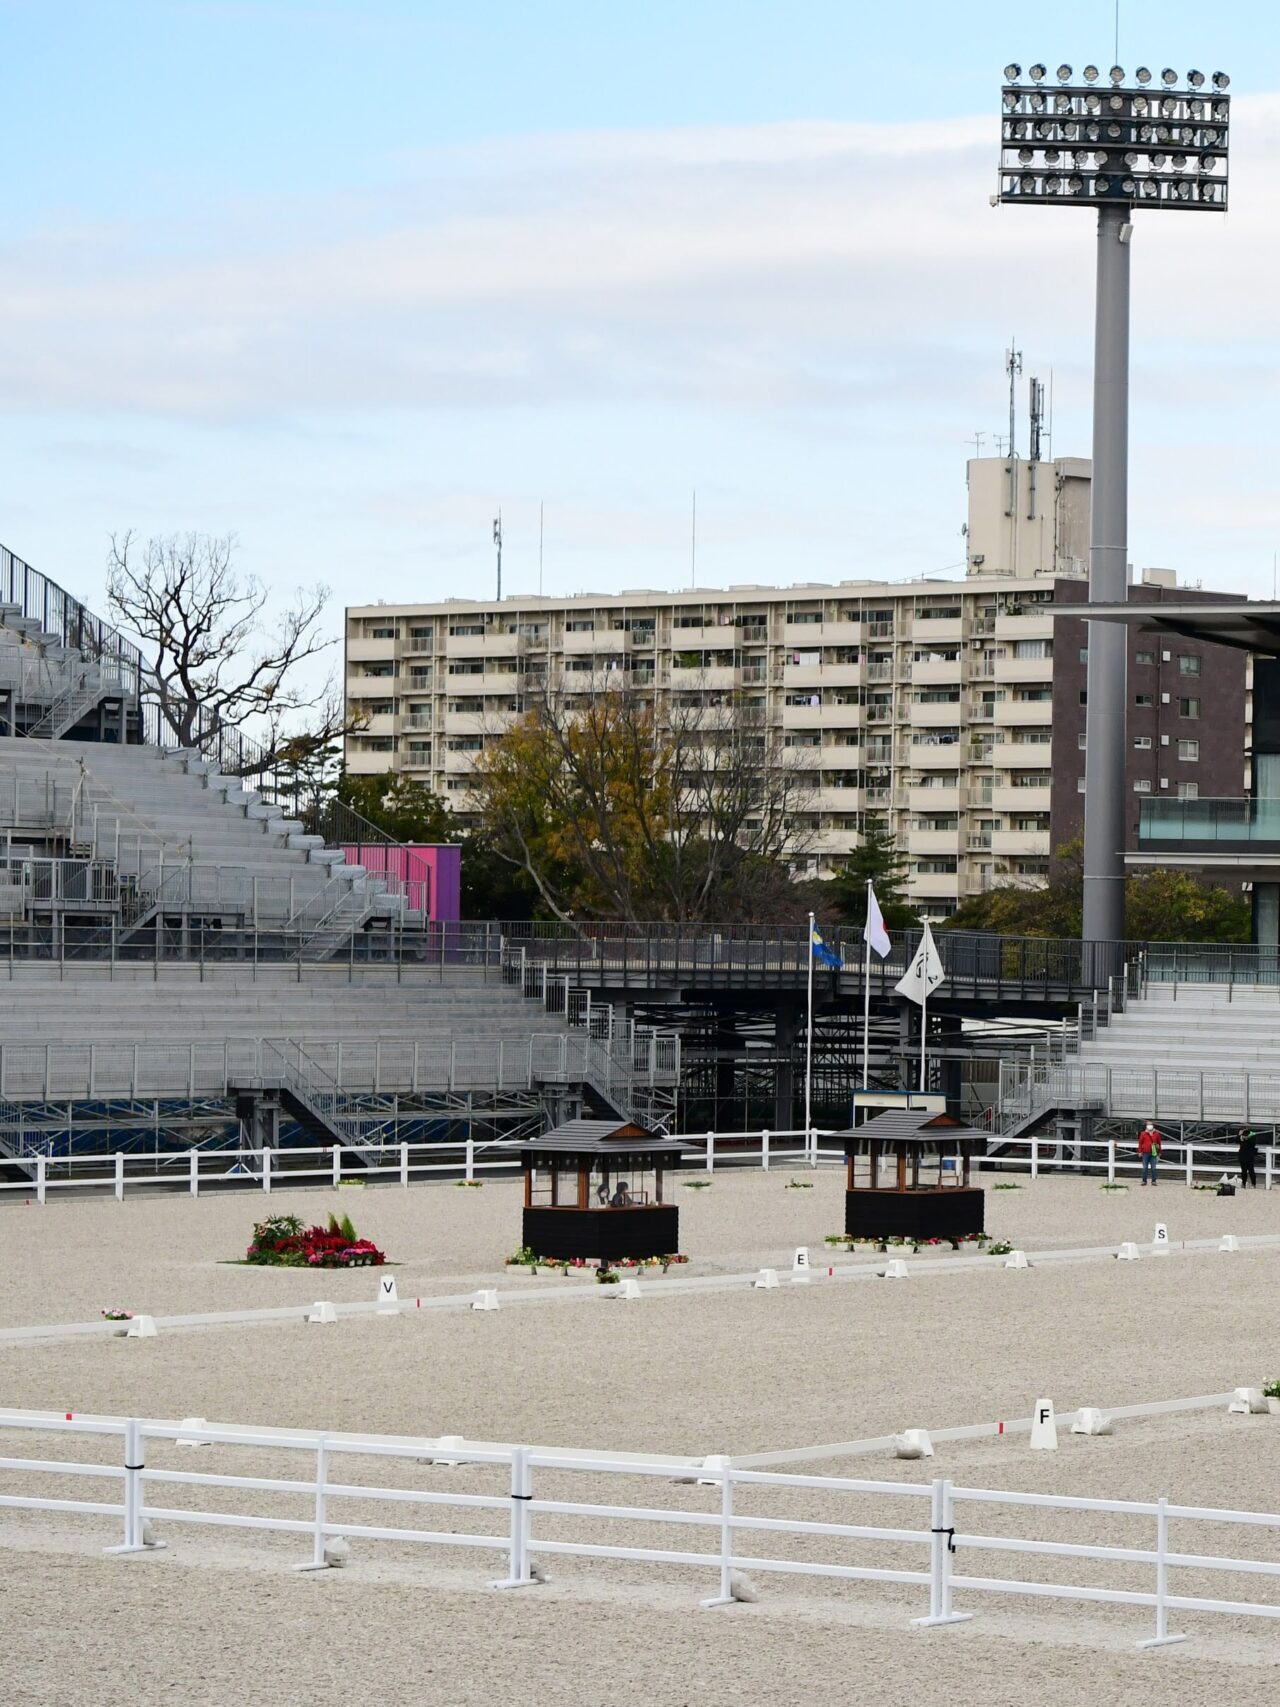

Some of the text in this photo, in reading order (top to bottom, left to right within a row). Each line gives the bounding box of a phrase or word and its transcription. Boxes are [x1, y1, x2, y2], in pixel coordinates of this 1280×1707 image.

[1158, 1229, 1165, 1239] S
[797, 1254, 805, 1265] E
[383, 1282, 393, 1293] V
[1040, 1409, 1050, 1424] F
